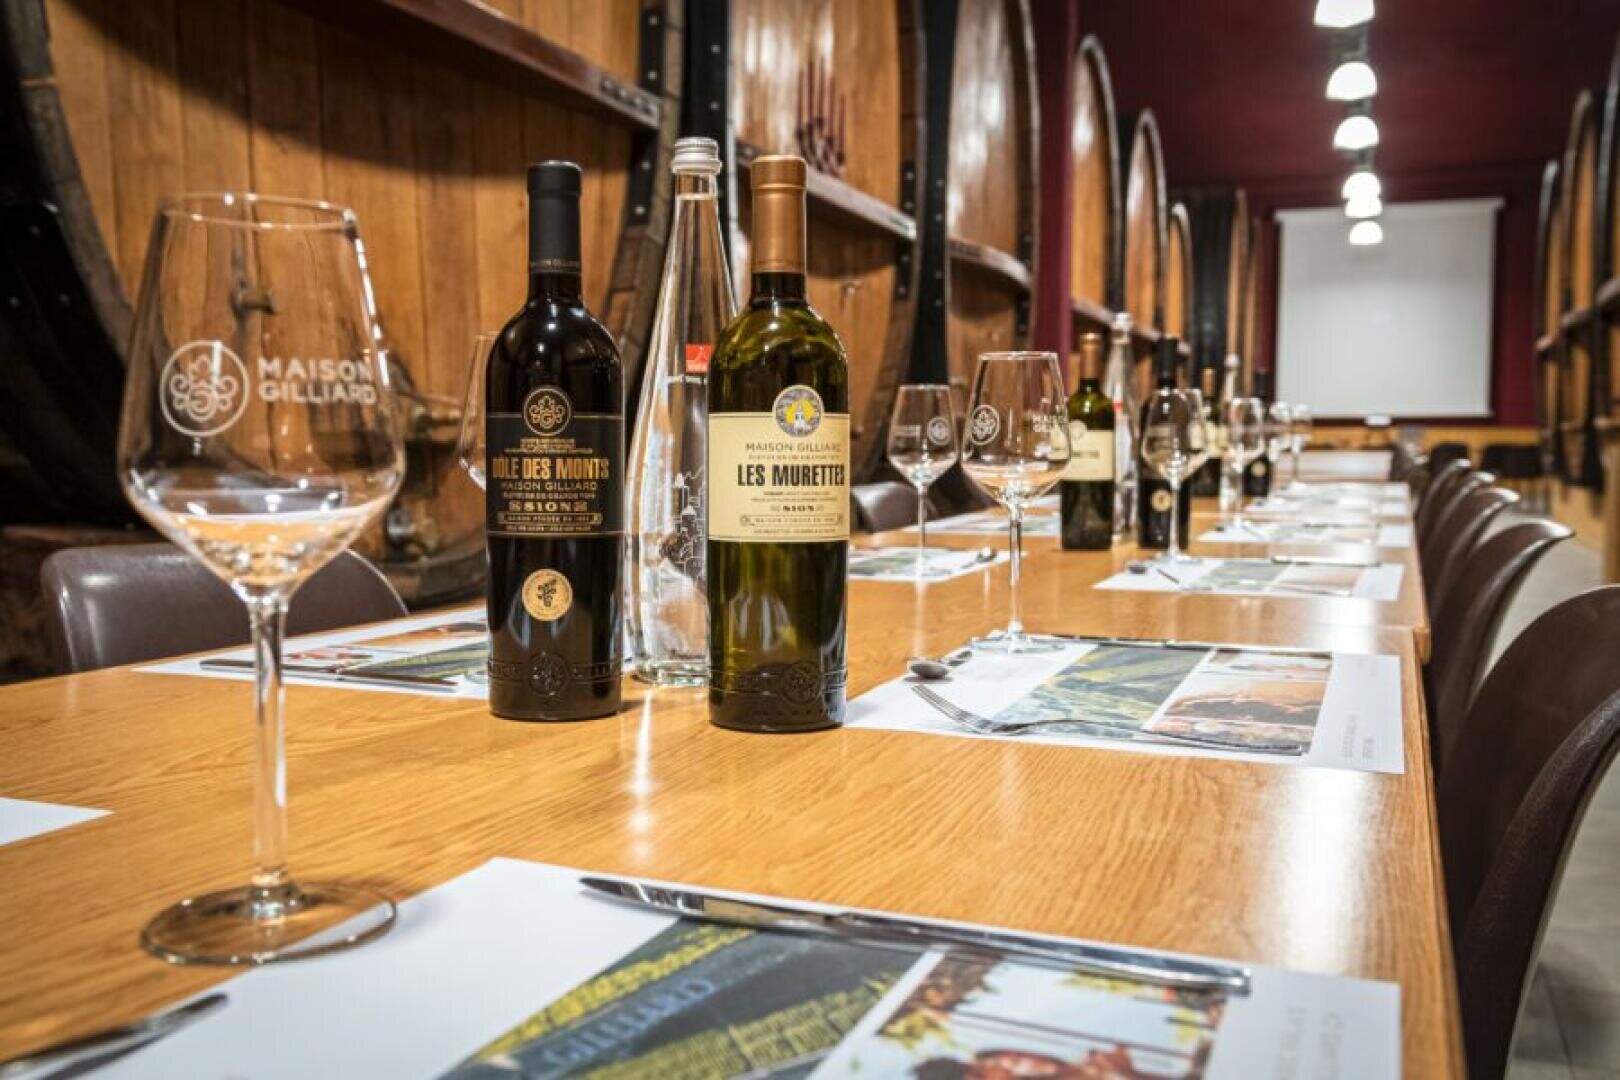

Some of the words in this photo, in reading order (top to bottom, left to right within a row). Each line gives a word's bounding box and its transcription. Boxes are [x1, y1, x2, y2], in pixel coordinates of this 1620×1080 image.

[257, 356, 373, 381] MAISON
[258, 380, 376, 406] GILLIARD
[745, 442, 792, 452] MAISON
[522, 457, 551, 479] DES
[555, 457, 609, 479] MONTS
[737, 464, 765, 486] LES
